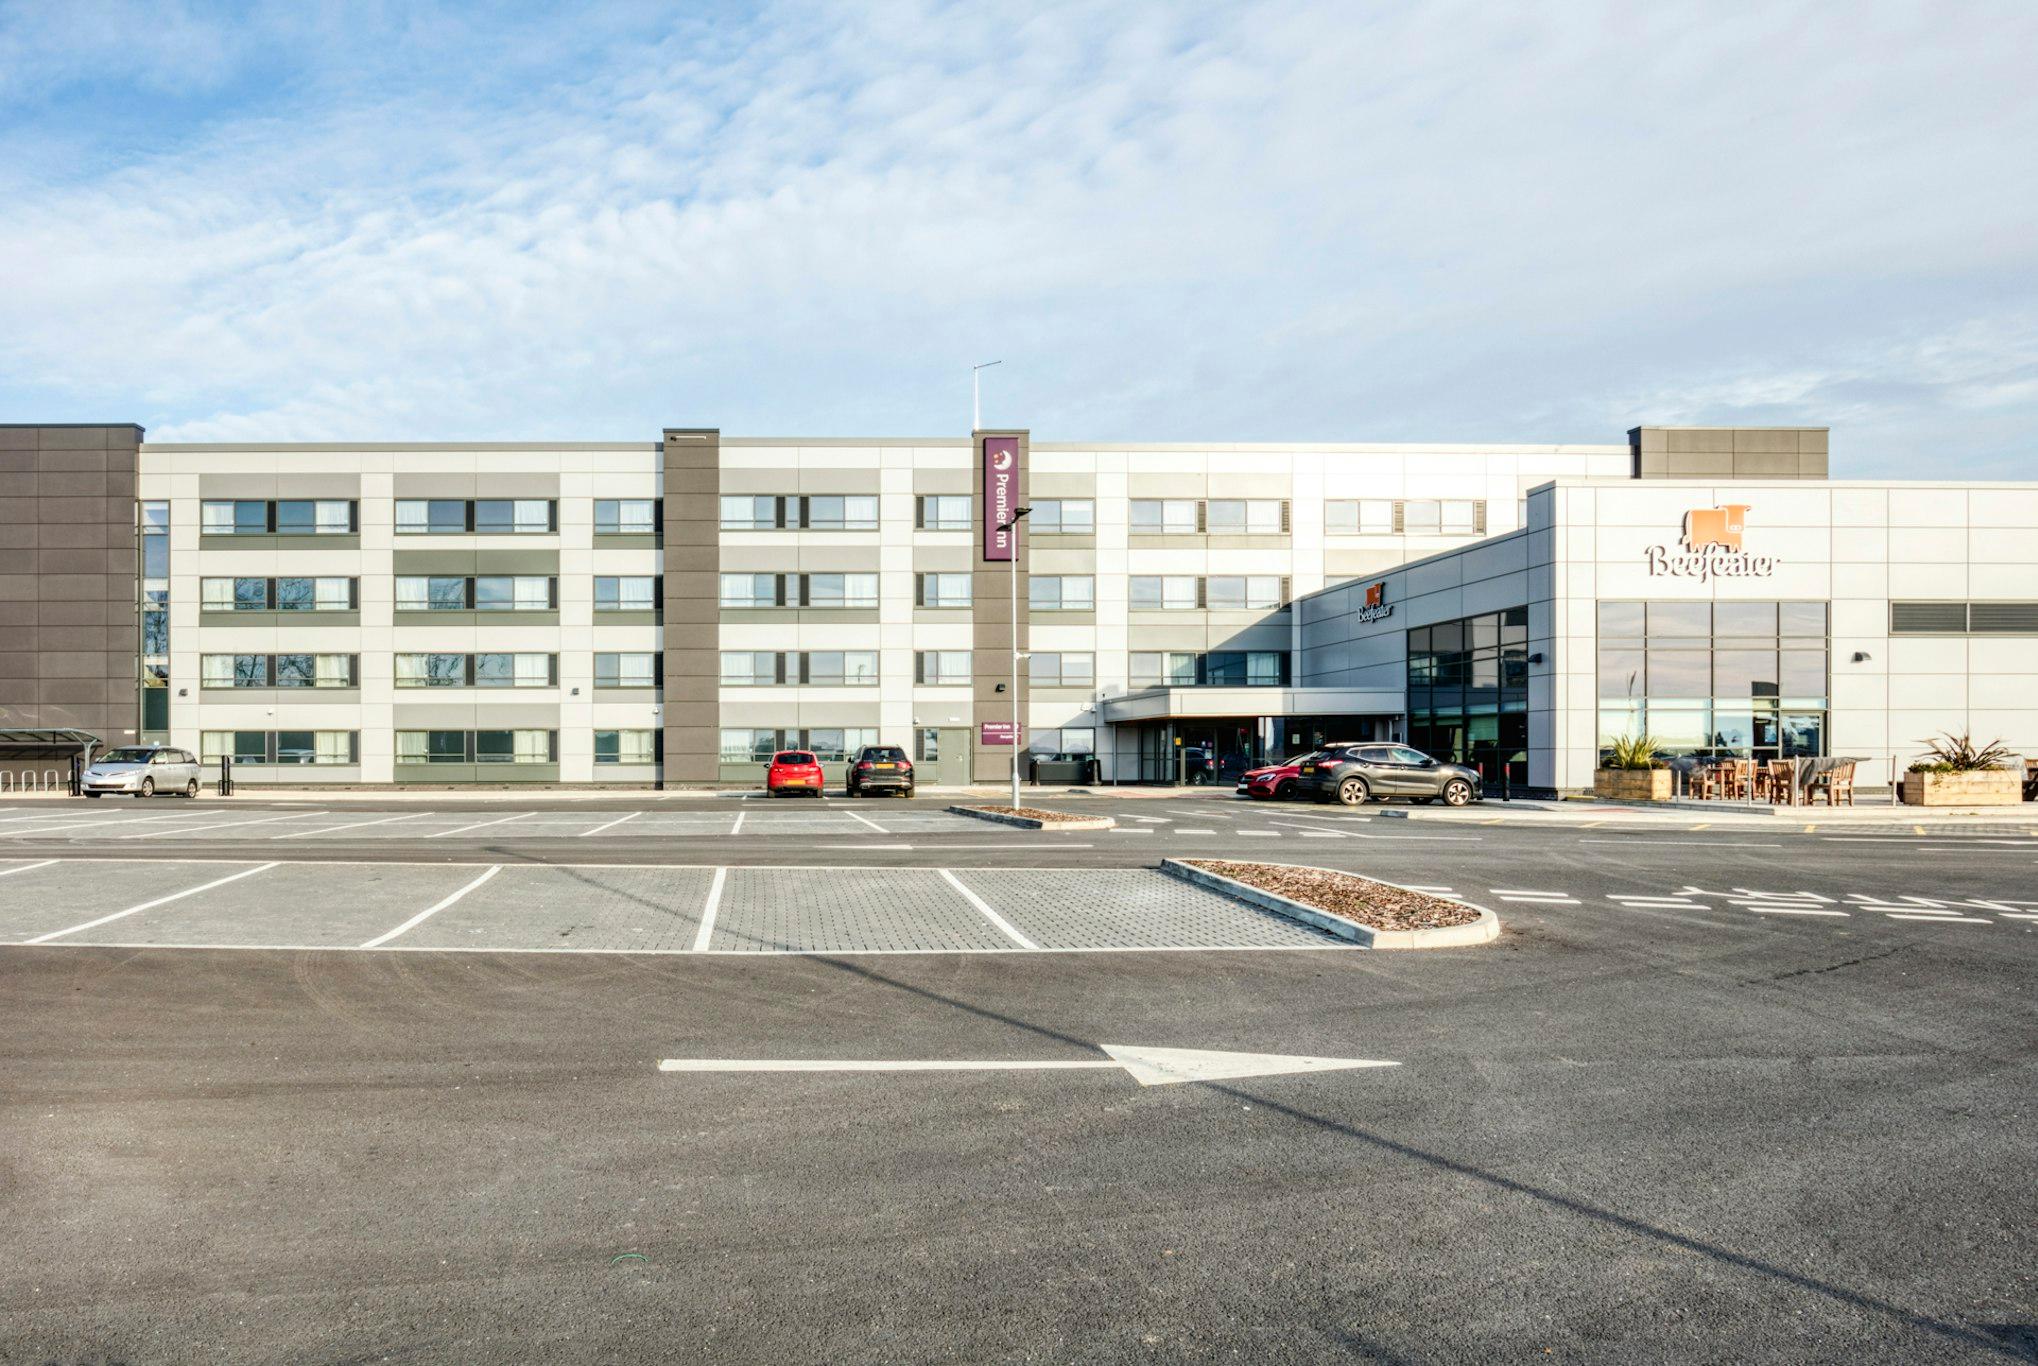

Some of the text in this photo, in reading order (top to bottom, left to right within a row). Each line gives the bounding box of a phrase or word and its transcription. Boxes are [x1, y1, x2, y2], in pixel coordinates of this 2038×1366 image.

[996, 473, 1010, 548] Premier nn
[1645, 541, 1781, 583] Beefeater
[1358, 604, 1393, 623] Beefeater
